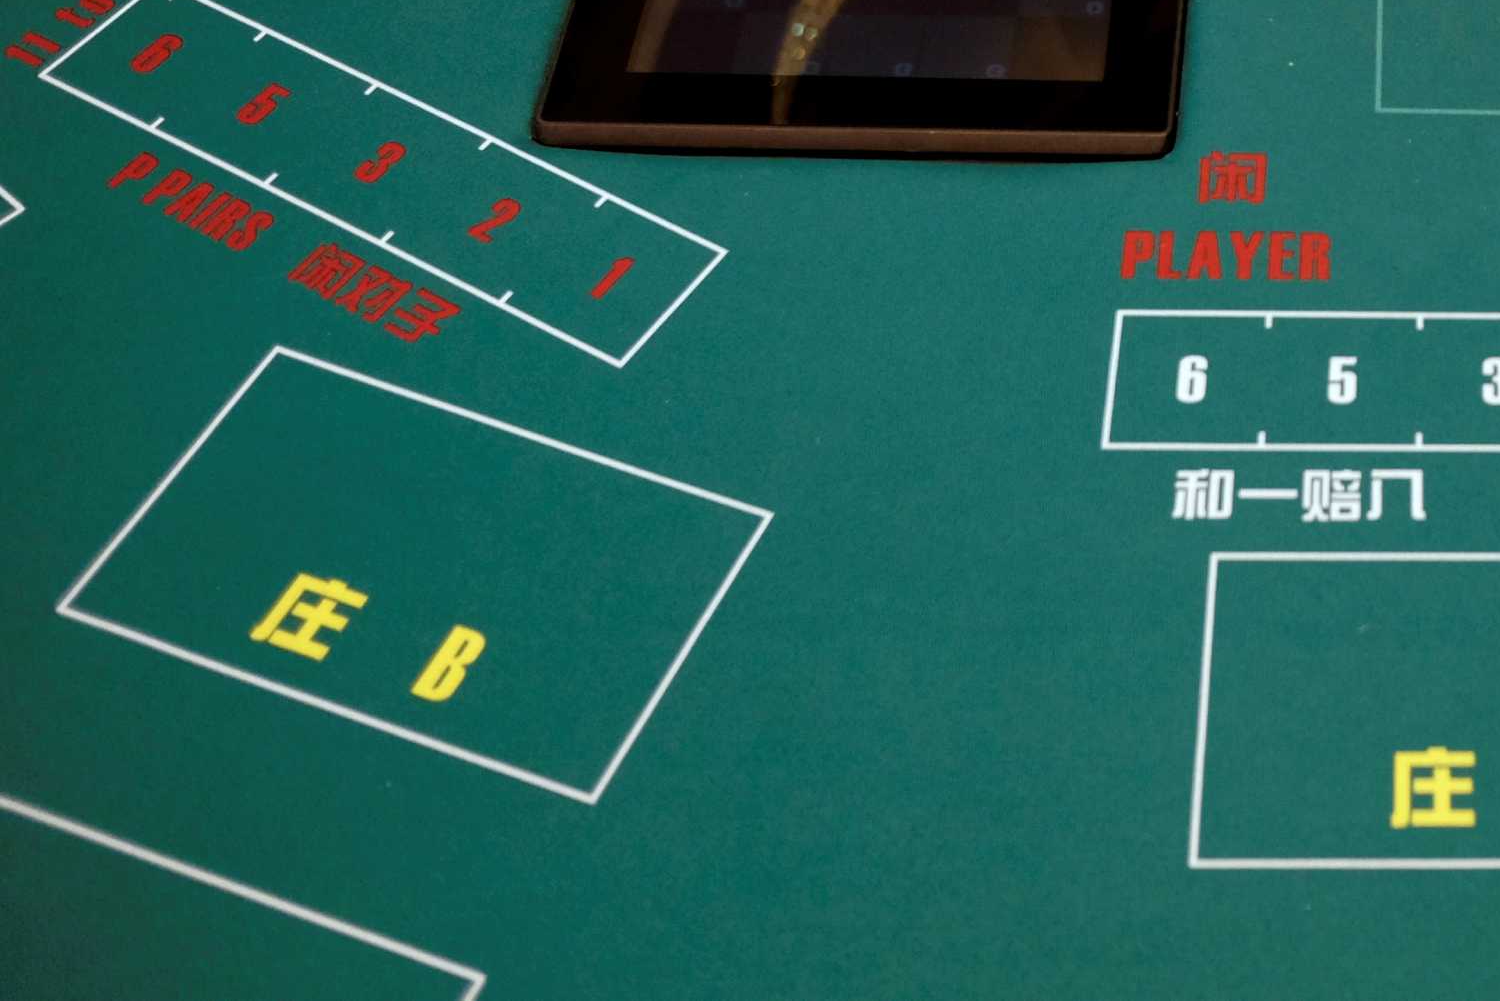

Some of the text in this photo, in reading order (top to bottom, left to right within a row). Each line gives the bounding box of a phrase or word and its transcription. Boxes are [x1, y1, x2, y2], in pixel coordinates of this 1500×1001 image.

[5, 31, 60, 67] 11
[131, 33, 635, 299] 6 5 3 2 1
[1197, 149, 1269, 205] 闲
[107, 151, 461, 343] P PAIRS 闲对子
[1119, 229, 1333, 281] PLAYER
[1174, 354, 1209, 404] 6
[1326, 355, 1358, 405] 5
[1171, 468, 1428, 522] 和一赔八
[248, 571, 487, 703] 庄 B
[1390, 745, 1477, 830] 庄
